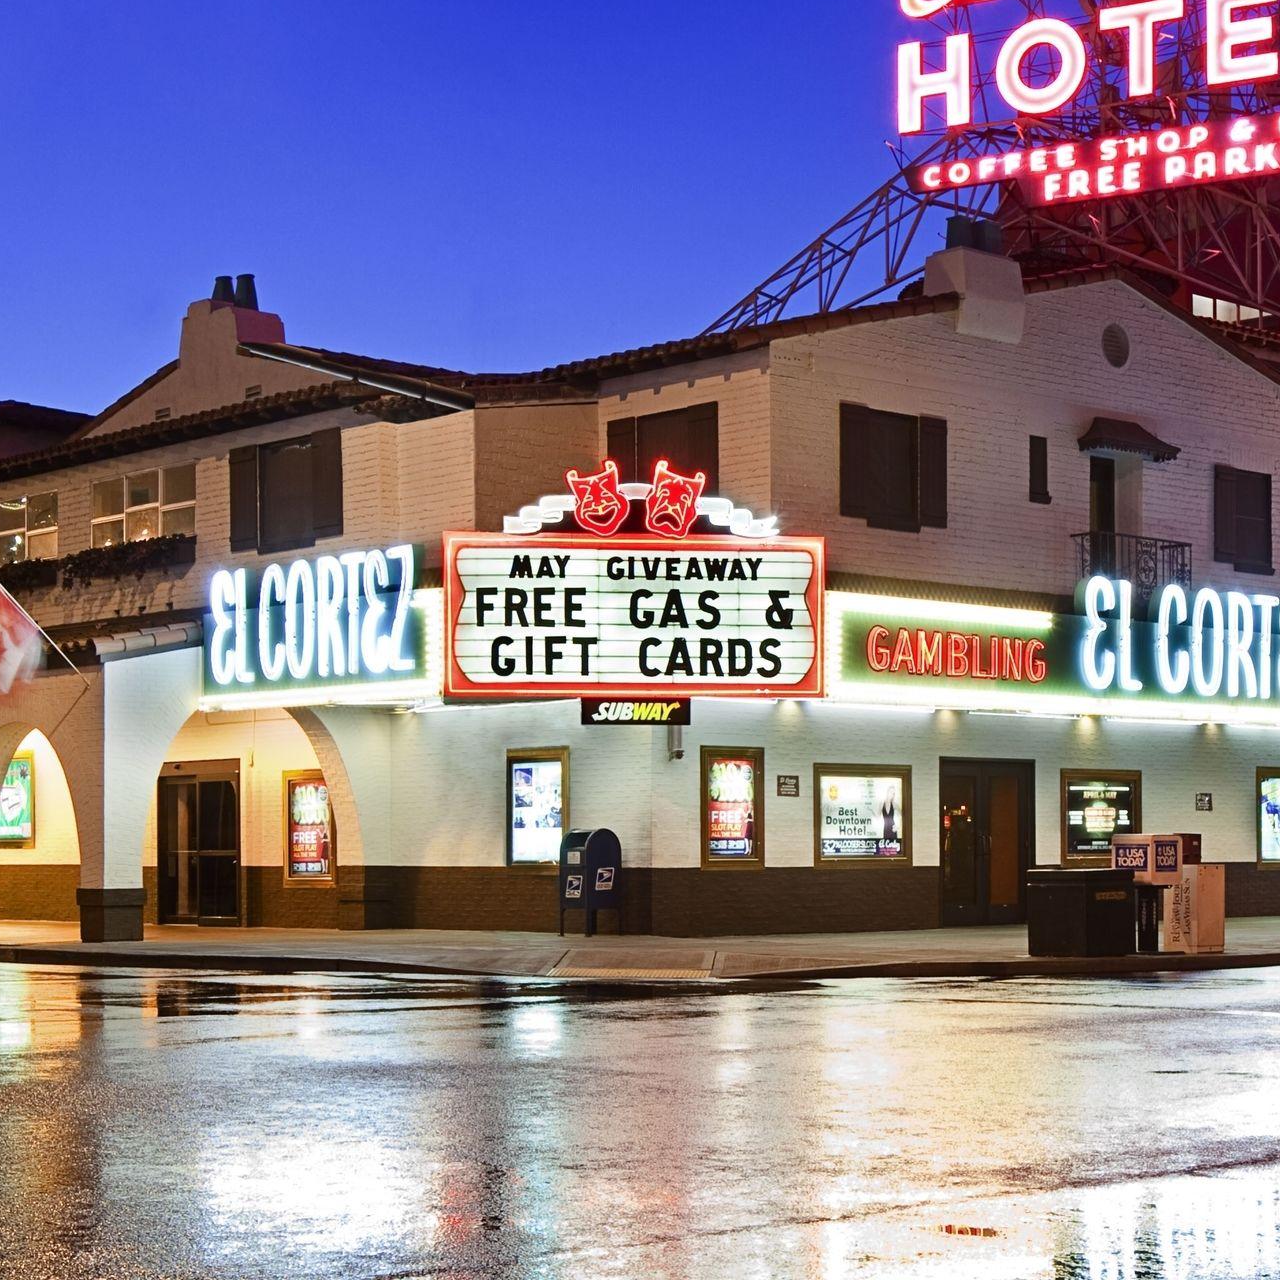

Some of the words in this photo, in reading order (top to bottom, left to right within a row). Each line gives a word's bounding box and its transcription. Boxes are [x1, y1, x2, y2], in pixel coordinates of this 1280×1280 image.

[922, 144, 1076, 188] COFFEE
[1100, 124, 1210, 161] SHOP
[1229, 117, 1257, 142] &
[1043, 161, 1142, 202] FREE
[508, 555, 571, 579] MAY
[606, 556, 763, 581] GIVEAWAY
[210, 567, 255, 685] EL
[258, 543, 416, 682] CORTEZ
[475, 587, 586, 627] FREE
[629, 588, 721, 630] GAS
[765, 590, 794, 630] &
[1081, 574, 1144, 692] EL
[490, 635, 598, 677] GIFT
[639, 637, 782, 678] CARDS
[866, 624, 1046, 684] GAMBLING
[591, 701, 681, 721] SUBWAY
[711, 810, 742, 823] FREE
[838, 806, 858, 816] Best
[825, 815, 872, 825] Downtown
[293, 831, 317, 844] FREE
[839, 825, 867, 836] Hotel
[1126, 848, 1145, 857] USA
[1162, 846, 1175, 856] USA
[1117, 857, 1146, 867] TODAY
[1157, 856, 1176, 866] TODAY
